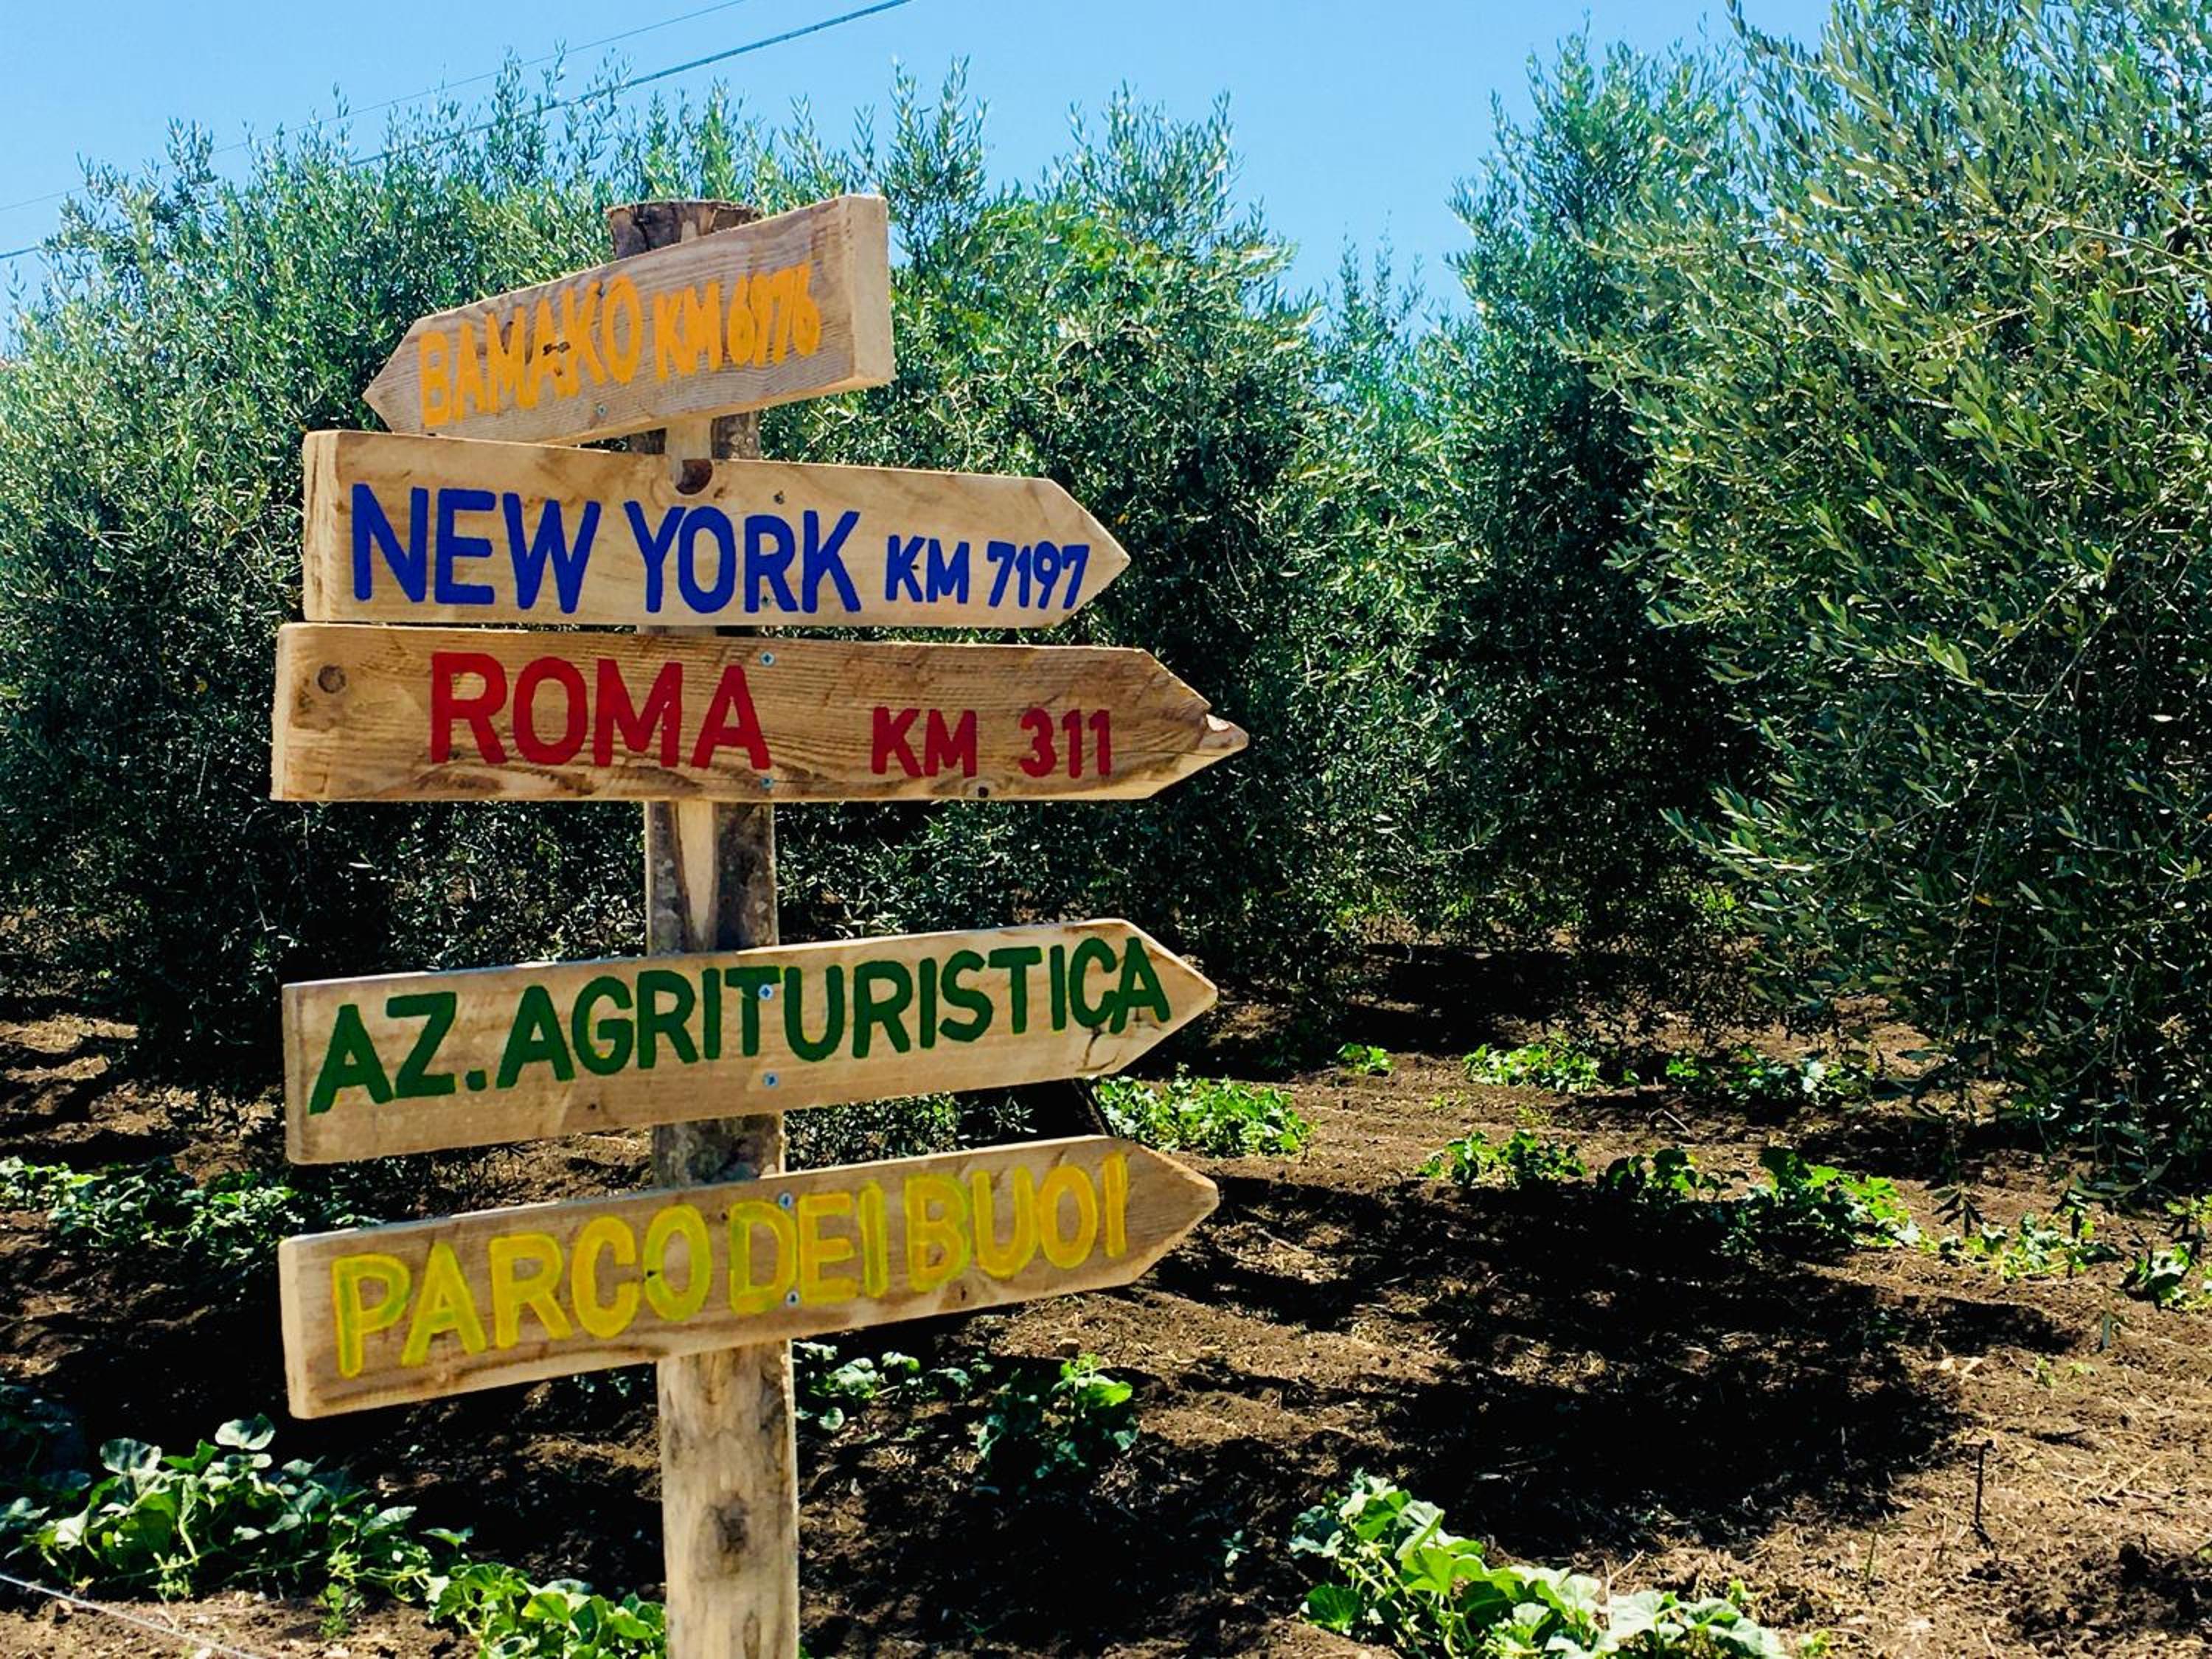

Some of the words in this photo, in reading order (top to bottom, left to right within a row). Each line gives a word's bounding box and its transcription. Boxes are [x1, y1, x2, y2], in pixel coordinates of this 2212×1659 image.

[419, 276, 643, 426] BAMAKO
[653, 282, 723, 382] KM
[352, 484, 601, 614] NEW
[624, 501, 861, 613] YORK
[886, 535, 970, 604] KM
[987, 541, 1090, 609] 7197
[429, 652, 771, 771] ROMA
[871, 706, 978, 779] KM
[1019, 706, 1113, 779] 311
[332, 1203, 712, 1378] PARCO
[728, 1180, 886, 1314] DEI
[905, 1152, 1129, 1294] BUOI
